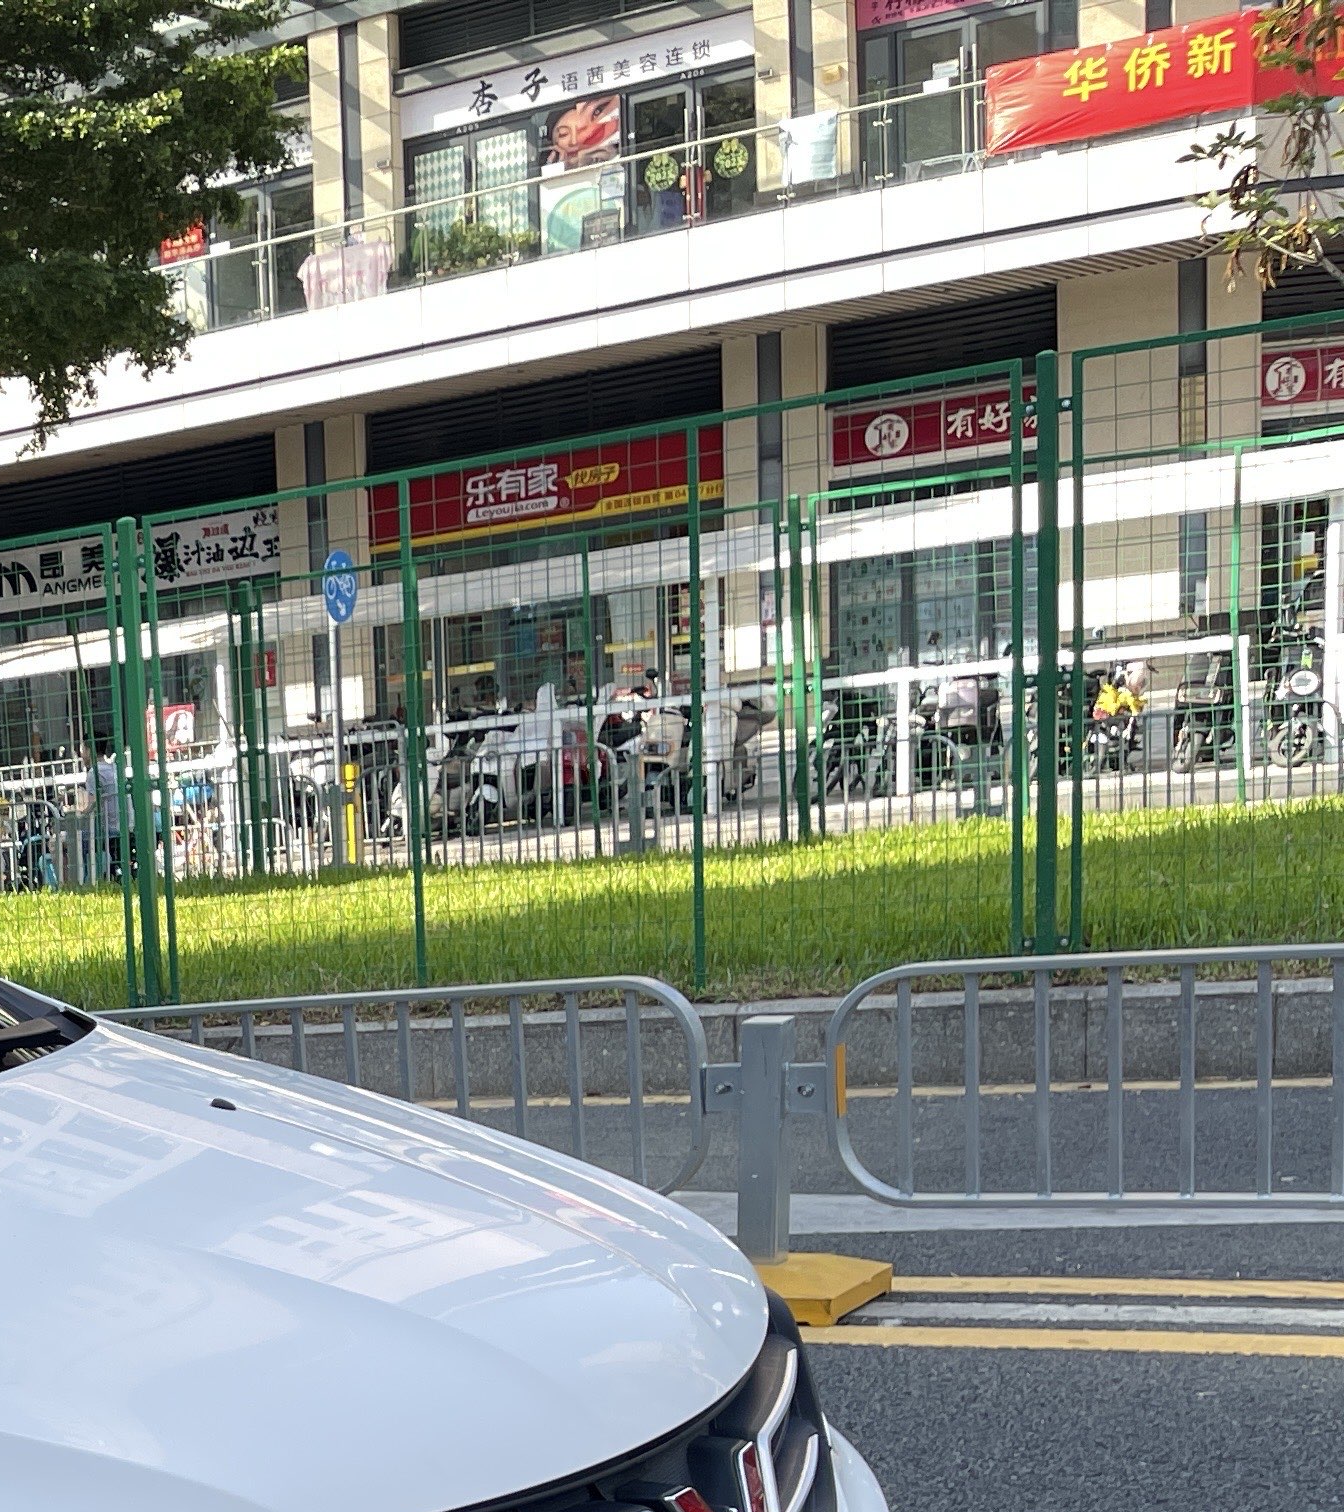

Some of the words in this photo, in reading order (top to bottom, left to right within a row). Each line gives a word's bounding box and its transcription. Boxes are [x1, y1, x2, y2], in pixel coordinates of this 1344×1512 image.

[468, 68, 549, 117] 杏子
[466, 463, 559, 507] 乐有家
[43, 573, 107, 596] ANGME
